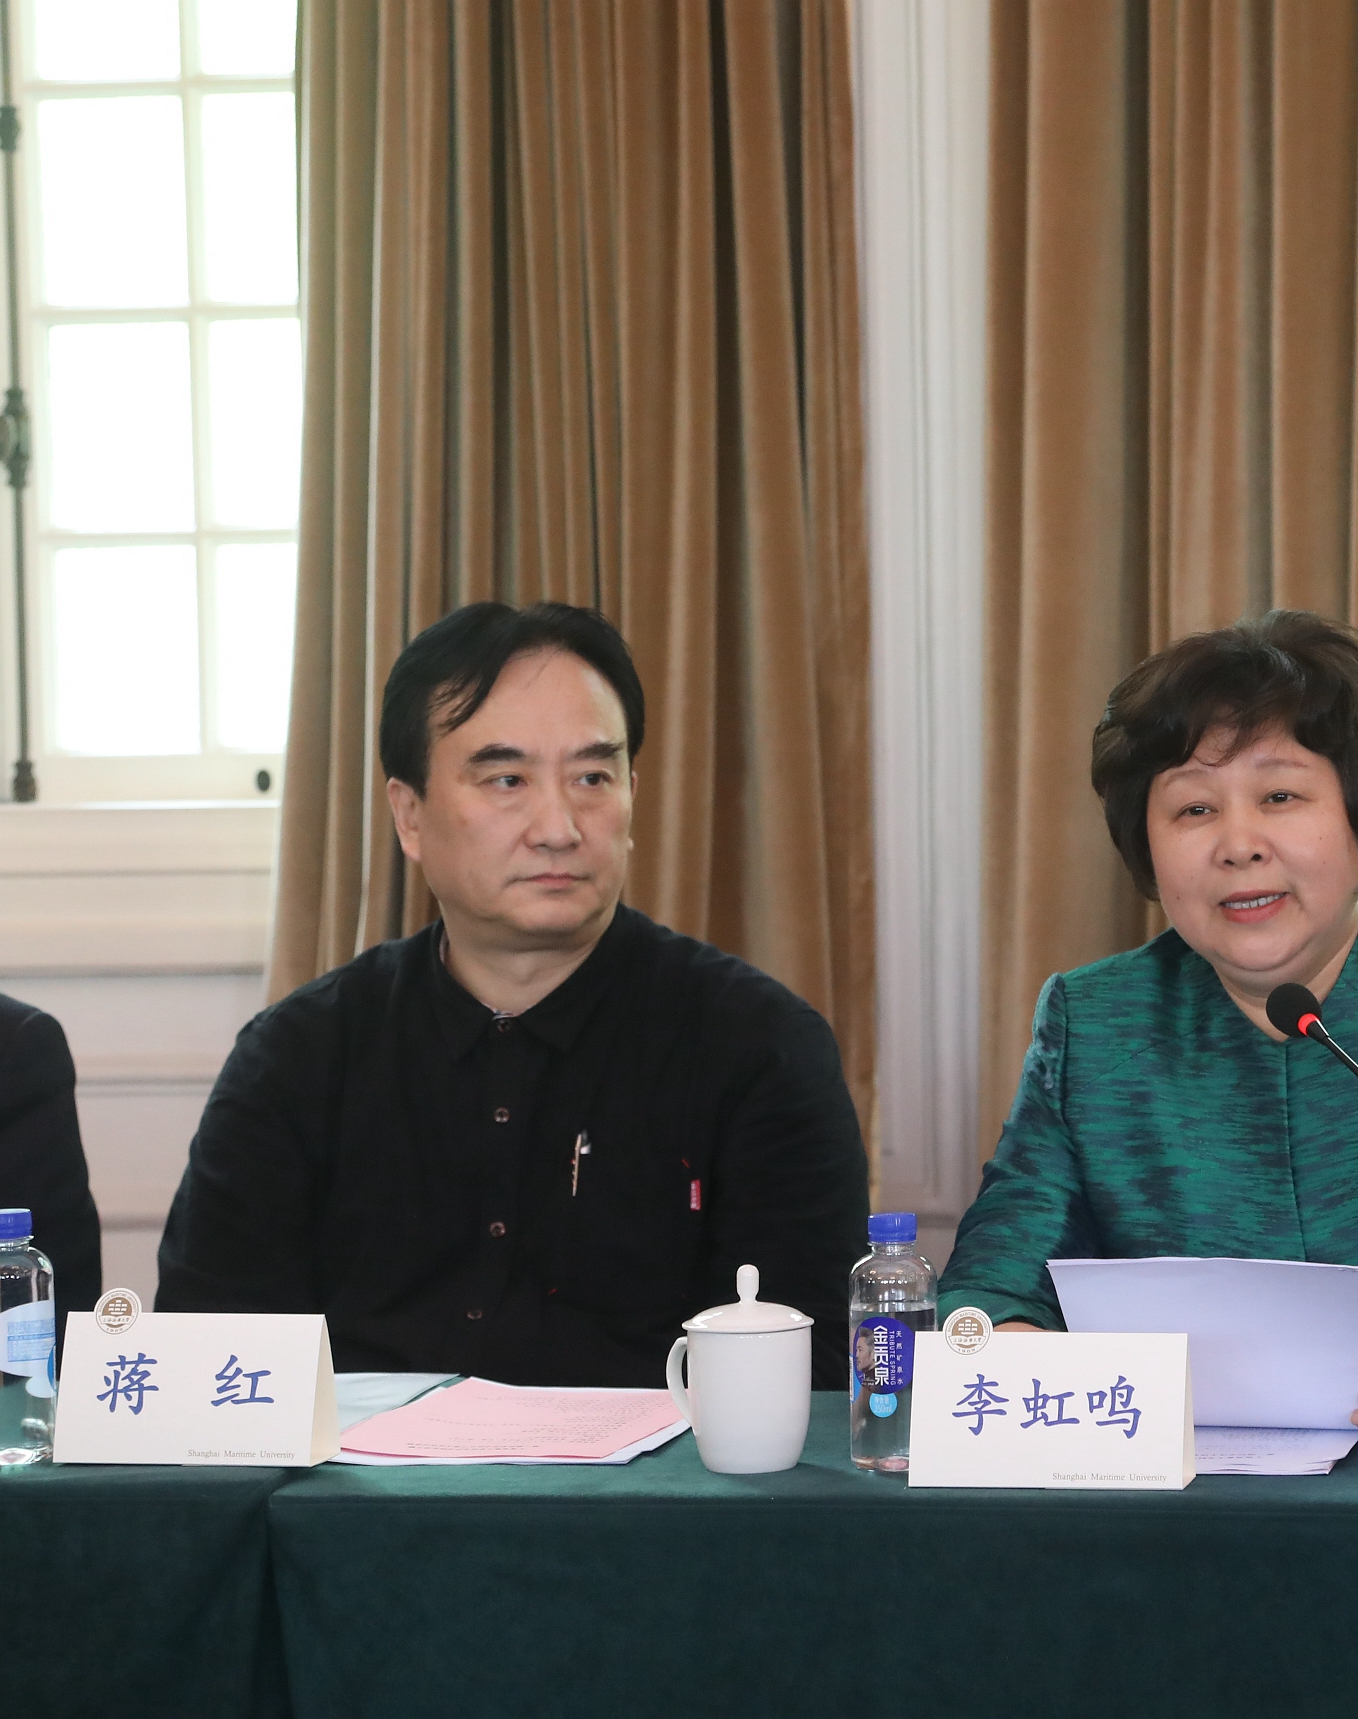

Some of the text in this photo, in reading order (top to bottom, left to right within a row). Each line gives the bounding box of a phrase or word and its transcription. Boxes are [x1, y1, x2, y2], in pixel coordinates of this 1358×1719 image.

[873, 1325, 889, 1386] 金贡泉
[952, 1374, 1142, 1438] 李虹鸣
[188, 1450, 295, 1460] Shanghai Maritime University
[1052, 1473, 1167, 1482] Shanghai Maritime University
